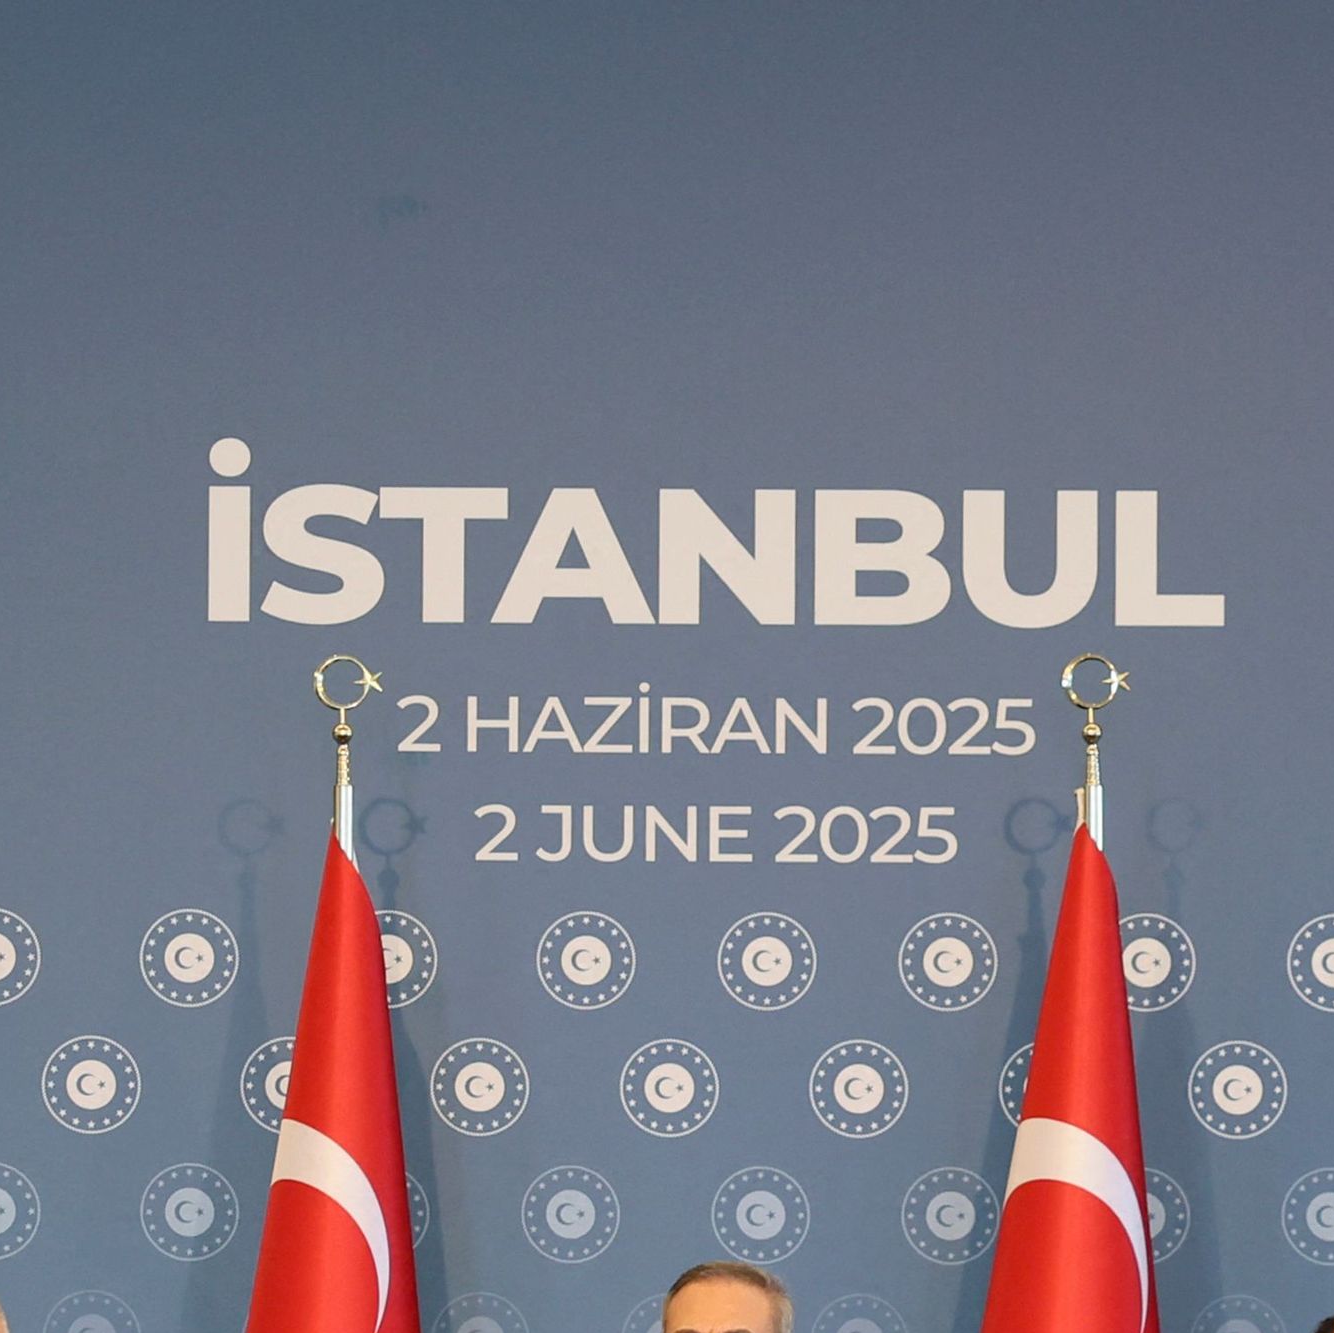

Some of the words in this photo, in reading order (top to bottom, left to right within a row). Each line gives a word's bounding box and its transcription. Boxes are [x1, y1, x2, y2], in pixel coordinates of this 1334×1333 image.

[207, 437, 1225, 629] İSTANBUL
[396, 695, 441, 752] 2
[467, 682, 828, 755] HAZİRAN
[851, 697, 1036, 756] 2025
[474, 804, 519, 861] 2
[535, 804, 753, 863] JUNE
[773, 805, 958, 864] 2025
